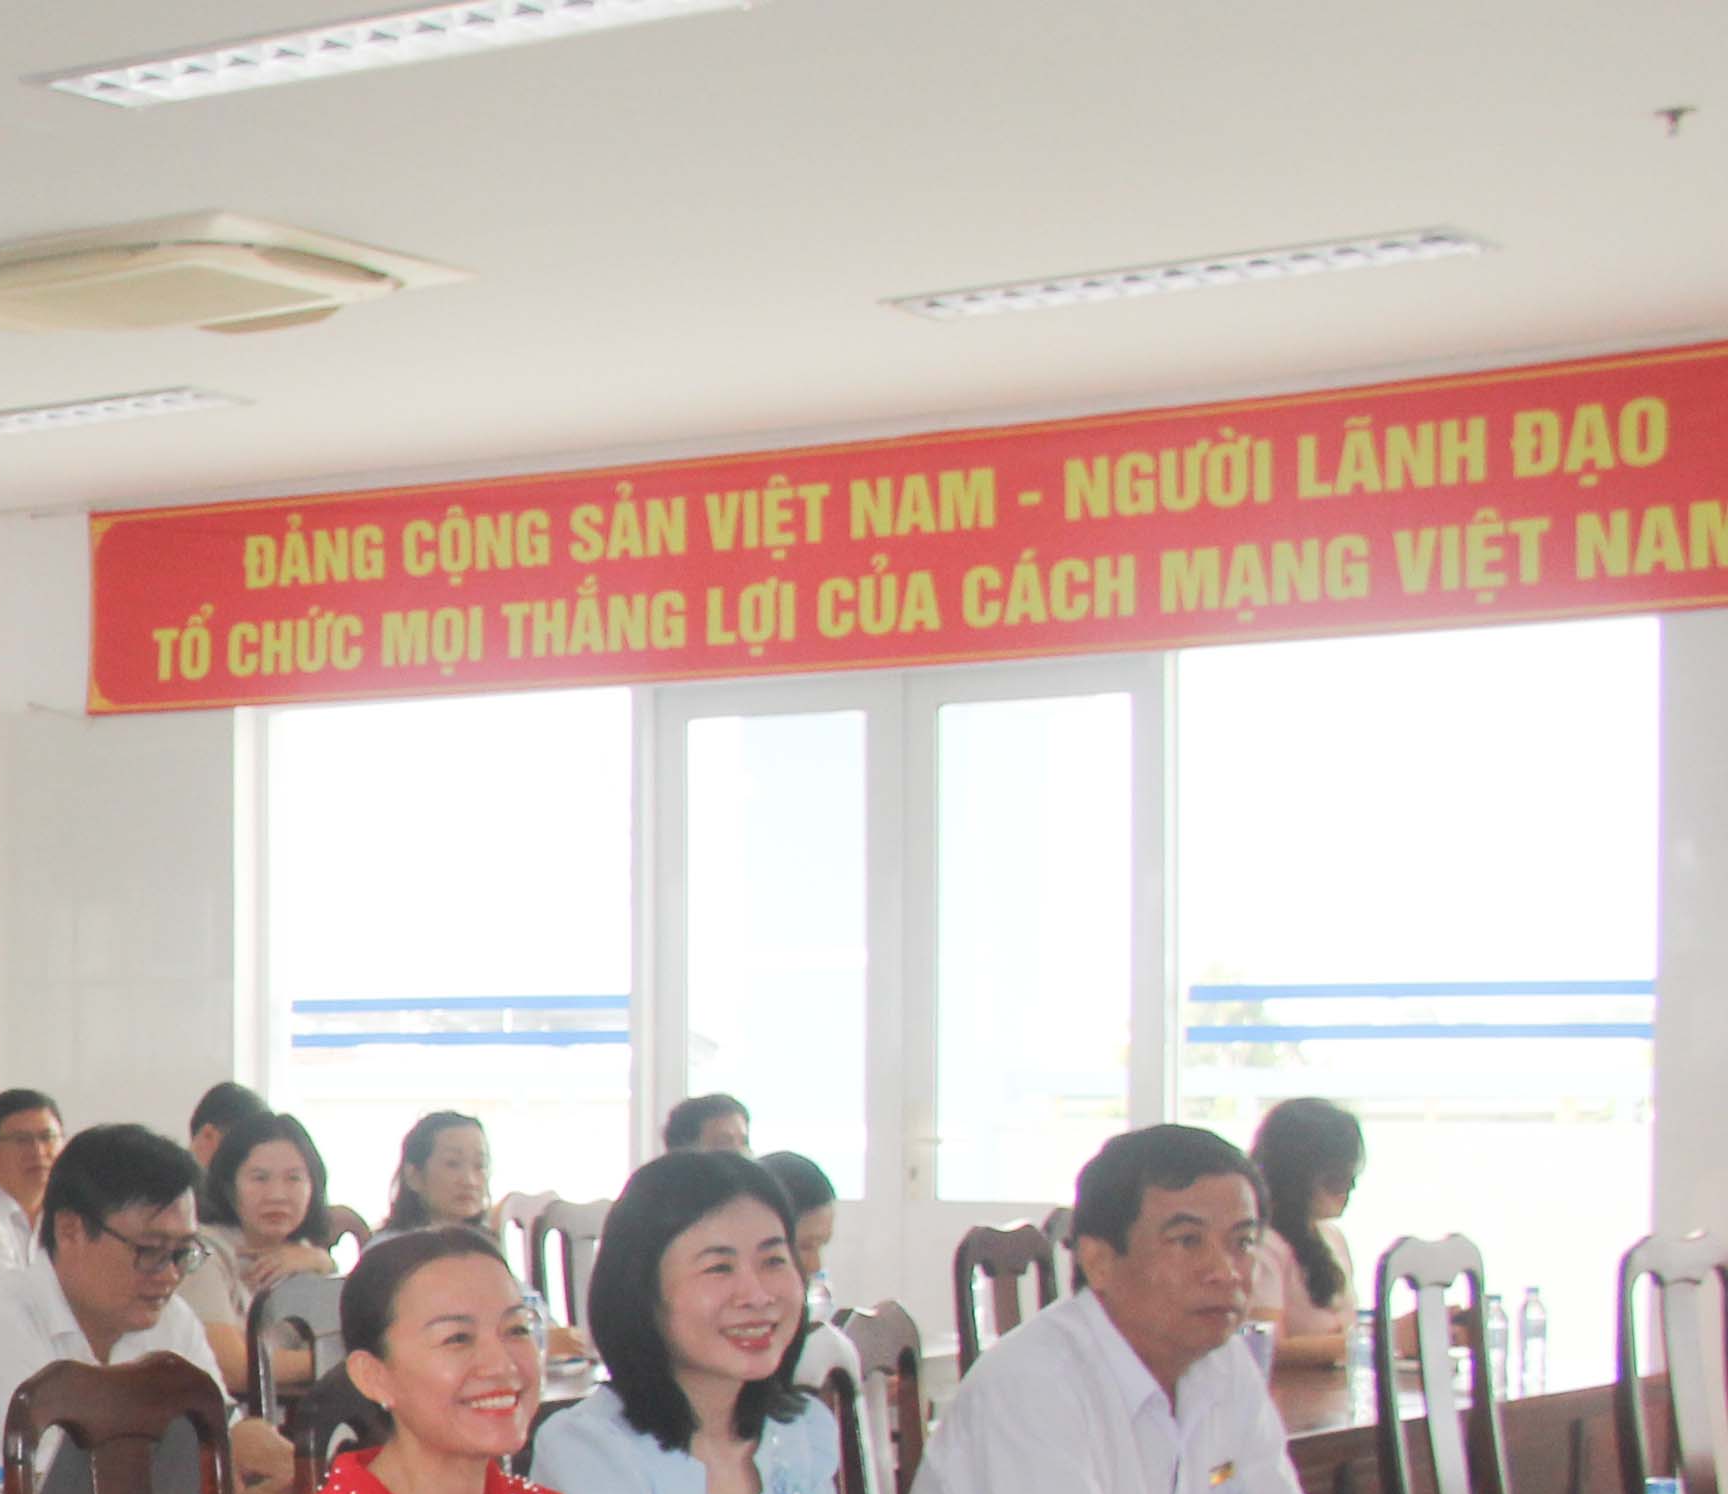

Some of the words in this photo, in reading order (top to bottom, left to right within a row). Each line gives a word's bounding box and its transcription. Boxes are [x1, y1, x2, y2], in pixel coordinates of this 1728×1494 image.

[244, 513, 386, 589] ĐẢNG
[402, 505, 550, 586] CỘNG
[569, 481, 687, 563] SẢN
[704, 473, 831, 560] VIỆT
[849, 466, 996, 539] NAM
[1063, 427, 1272, 522] NGƯỜI
[1297, 415, 1486, 501] LÃNH
[1511, 396, 1668, 487] ĐẠO
[152, 603, 212, 682] TỔ
[227, 605, 363, 678] CHỨC
[380, 605, 484, 676] MỌI
[501, 574, 686, 660] THẮNG
[706, 576, 797, 656] LỢI
[817, 553, 941, 639] CỦA
[962, 548, 1136, 628] CÁCH
[1159, 533, 1370, 623] MẠNG
[1393, 508, 1550, 603] VIỆT
